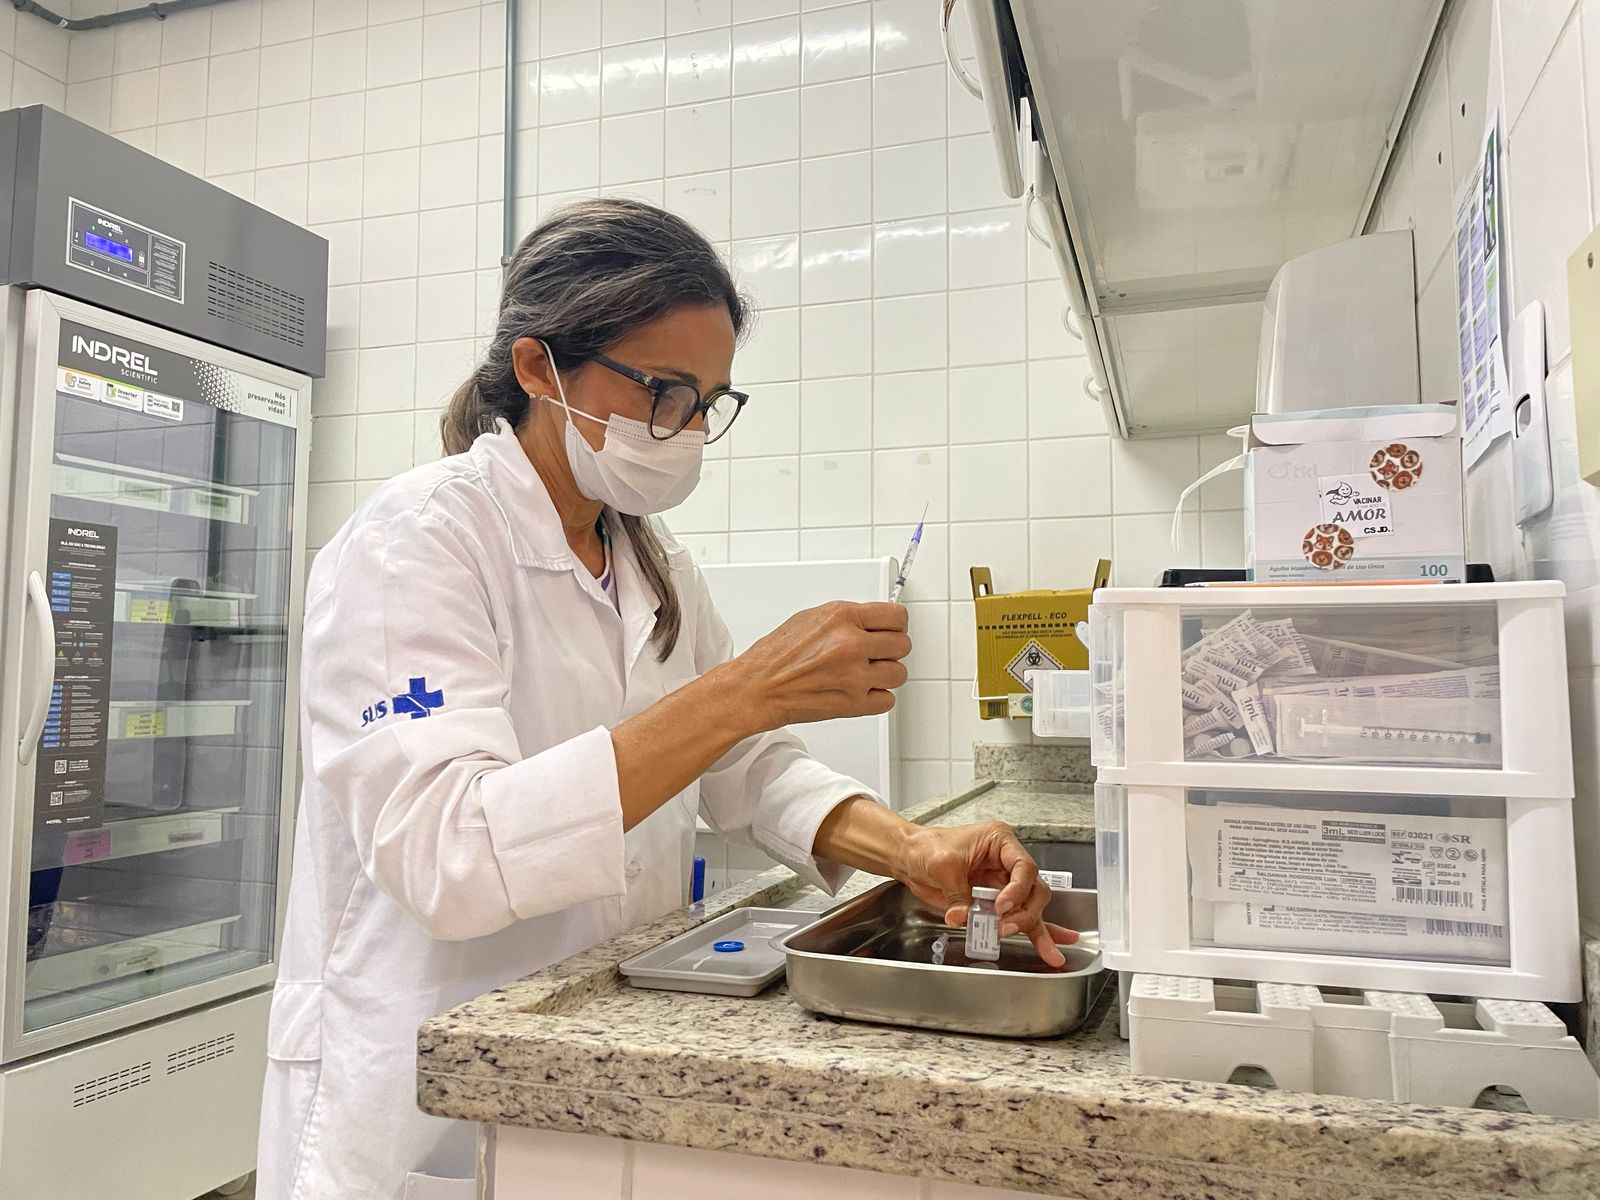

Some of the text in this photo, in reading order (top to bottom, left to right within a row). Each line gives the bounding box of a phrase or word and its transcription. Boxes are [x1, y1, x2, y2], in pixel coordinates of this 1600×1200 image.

[72, 335, 158, 376] INDREL
[121, 369, 158, 384] SCIENTIFIC
[247, 393, 286, 408] preservamos
[274, 392, 286, 401] Nós
[1353, 496, 1382, 505] VACINAR
[1332, 508, 1386, 523] AMOR
[67, 527, 100, 539] INDREL
[1420, 564, 1448, 577] 100
[1002, 613, 1042, 621] FLEXPELL
[1050, 612, 1067, 620] ECO
[1235, 657, 1257, 673] 1mL
[1216, 674, 1238, 691] 1mL
[361, 700, 387, 727] SUS
[1217, 702, 1238, 722] 1mL
[1244, 696, 1259, 722] 1mL
[1323, 826, 1345, 836] 3mL
[1408, 832, 1433, 840] 03021
[1451, 834, 1472, 844] SR
